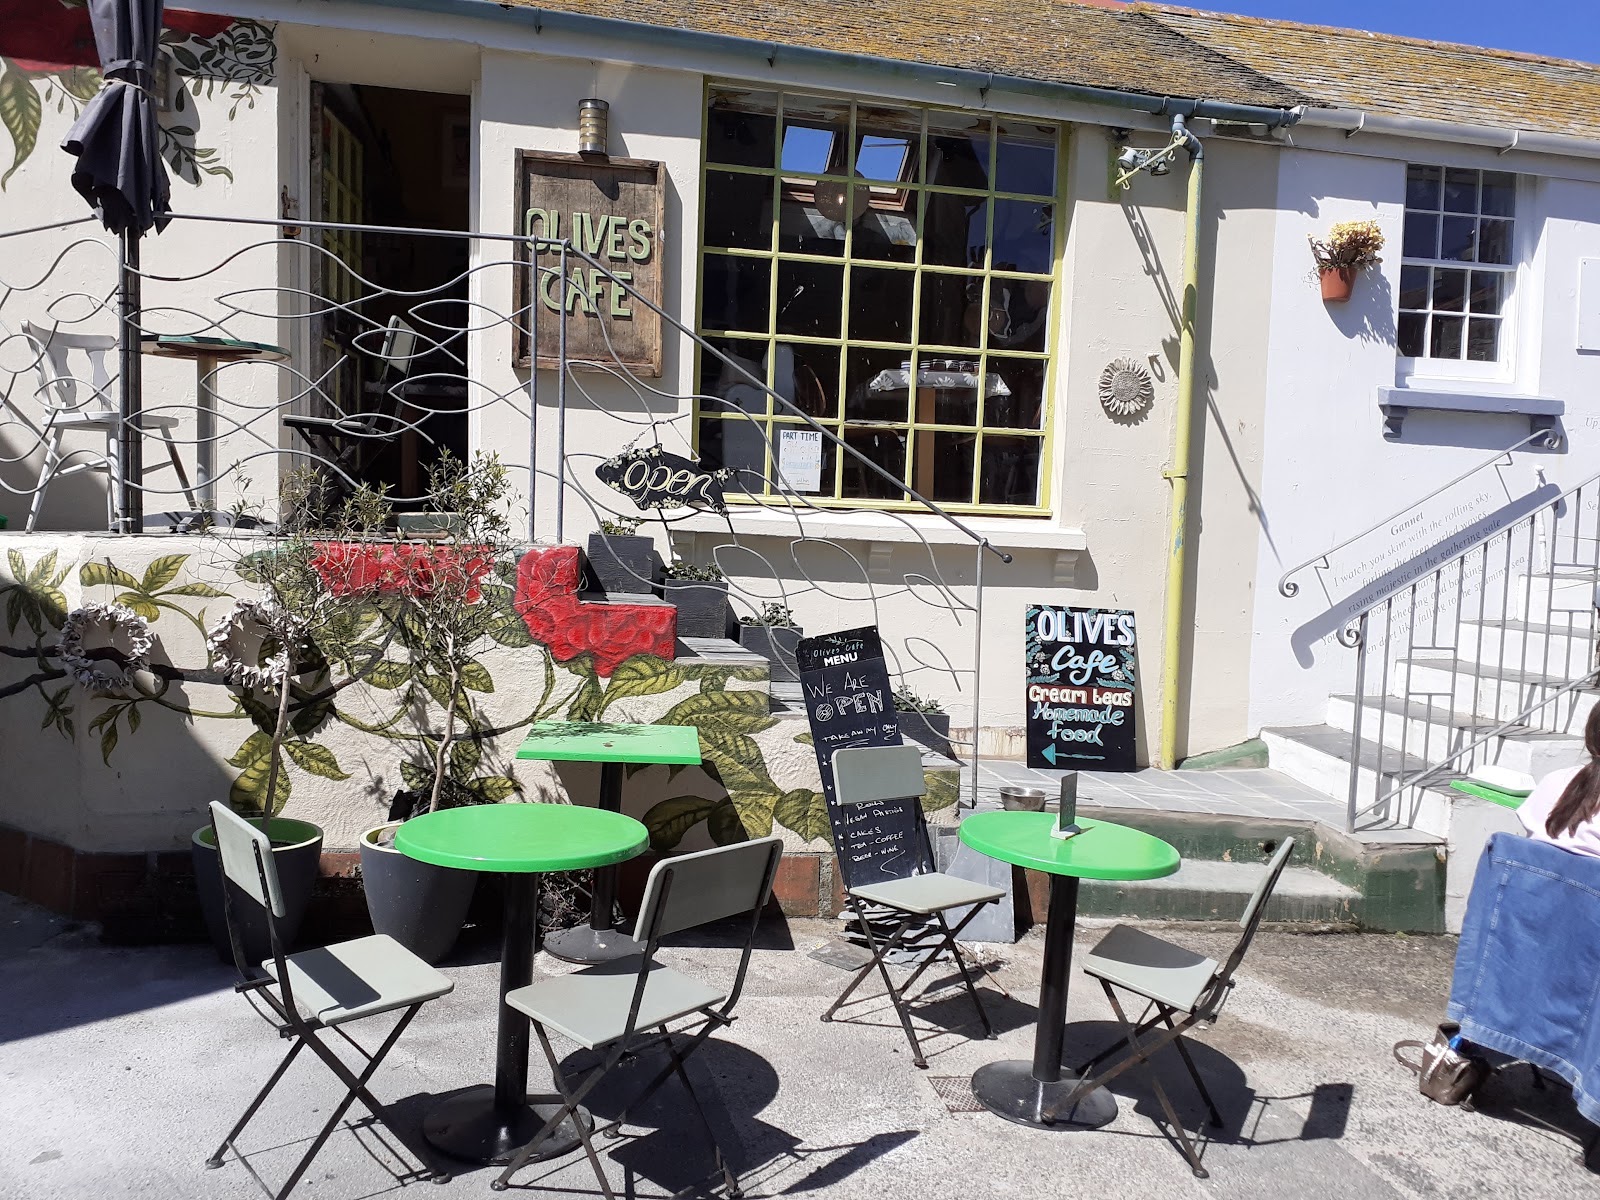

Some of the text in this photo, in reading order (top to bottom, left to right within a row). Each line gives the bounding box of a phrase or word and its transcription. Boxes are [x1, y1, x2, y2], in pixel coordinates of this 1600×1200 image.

[525, 208, 653, 260] OLIVES
[540, 267, 632, 317] CAFE
[782, 431, 819, 442] PART TIME
[1390, 511, 1424, 536] Gannet
[1333, 577, 1339, 588] I
[1341, 561, 1368, 583] watch
[1369, 553, 1386, 570] you
[1387, 540, 1407, 557] skim
[1408, 527, 1428, 543] with
[1429, 520, 1442, 532] the
[1444, 502, 1474, 523] rolling
[1361, 566, 1393, 589] furling
[1394, 558, 1407, 570] the
[1409, 544, 1430, 561] deep
[1431, 525, 1459, 546] curled
[1348, 519, 1501, 613] rising majestic in the gathering gale
[1320, 632, 1338, 646] You
[1370, 602, 1388, 618] bod
[1392, 591, 1412, 604] lies
[1415, 575, 1435, 591] tark
[1488, 533, 1507, 549] lack
[1431, 583, 1447, 600] ad
[1448, 564, 1483, 589] baking
[1037, 610, 1135, 646] OLIVES
[1379, 631, 1397, 647] drt
[813, 642, 864, 658] Olives Cafe
[823, 652, 858, 667] MENU
[1051, 644, 1119, 686] Cafe
[806, 671, 869, 699] WE ARE
[1028, 685, 1133, 706] Cream teas
[815, 689, 884, 722] OPEN
[1032, 702, 1125, 726] Homemade
[850, 826, 882, 839] CAKES
[850, 842, 867, 850] TEA
[875, 831, 904, 844] COFFEE
[851, 852, 872, 862] BEER
[880, 845, 899, 855] WINE
